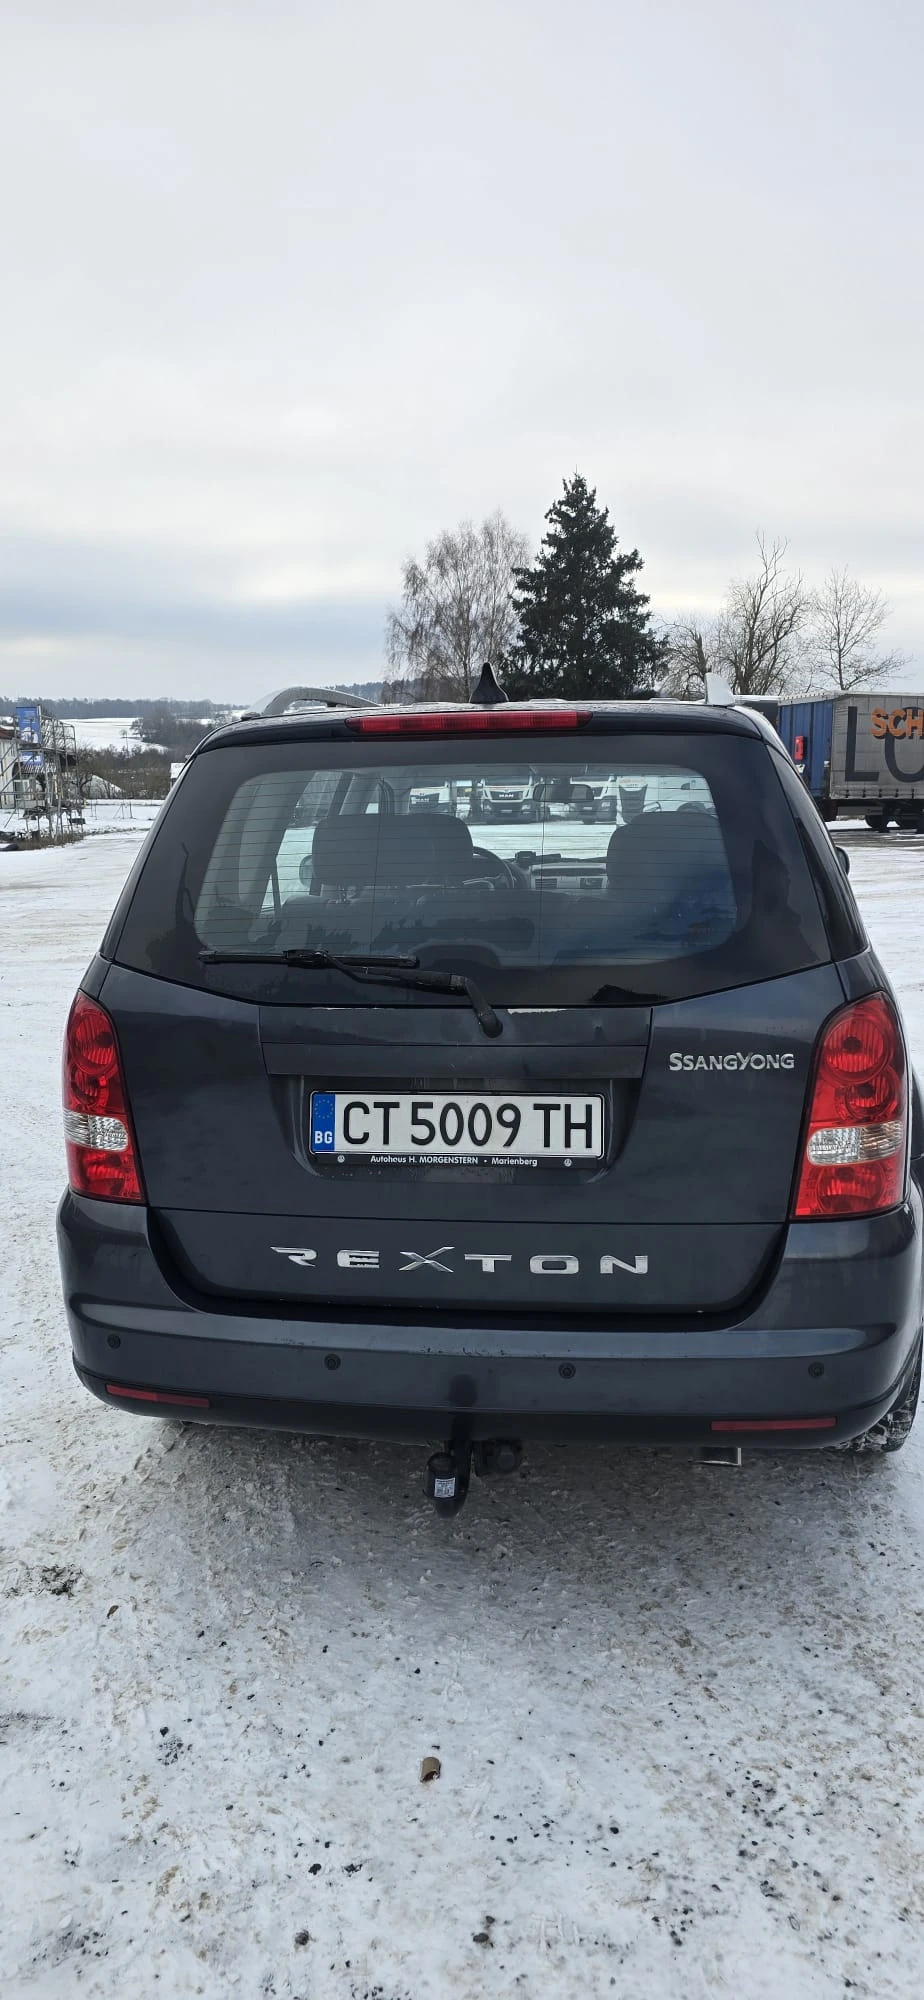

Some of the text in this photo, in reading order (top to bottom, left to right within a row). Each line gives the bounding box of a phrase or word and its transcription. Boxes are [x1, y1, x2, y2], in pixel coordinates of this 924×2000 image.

[343, 1101, 593, 1149] CT 5009 TH
[314, 1130, 333, 1144] BG
[370, 1154, 538, 1168] Autohaus H. MORGENSTERN Marienberg
[270, 1246, 649, 1275] REXTON
